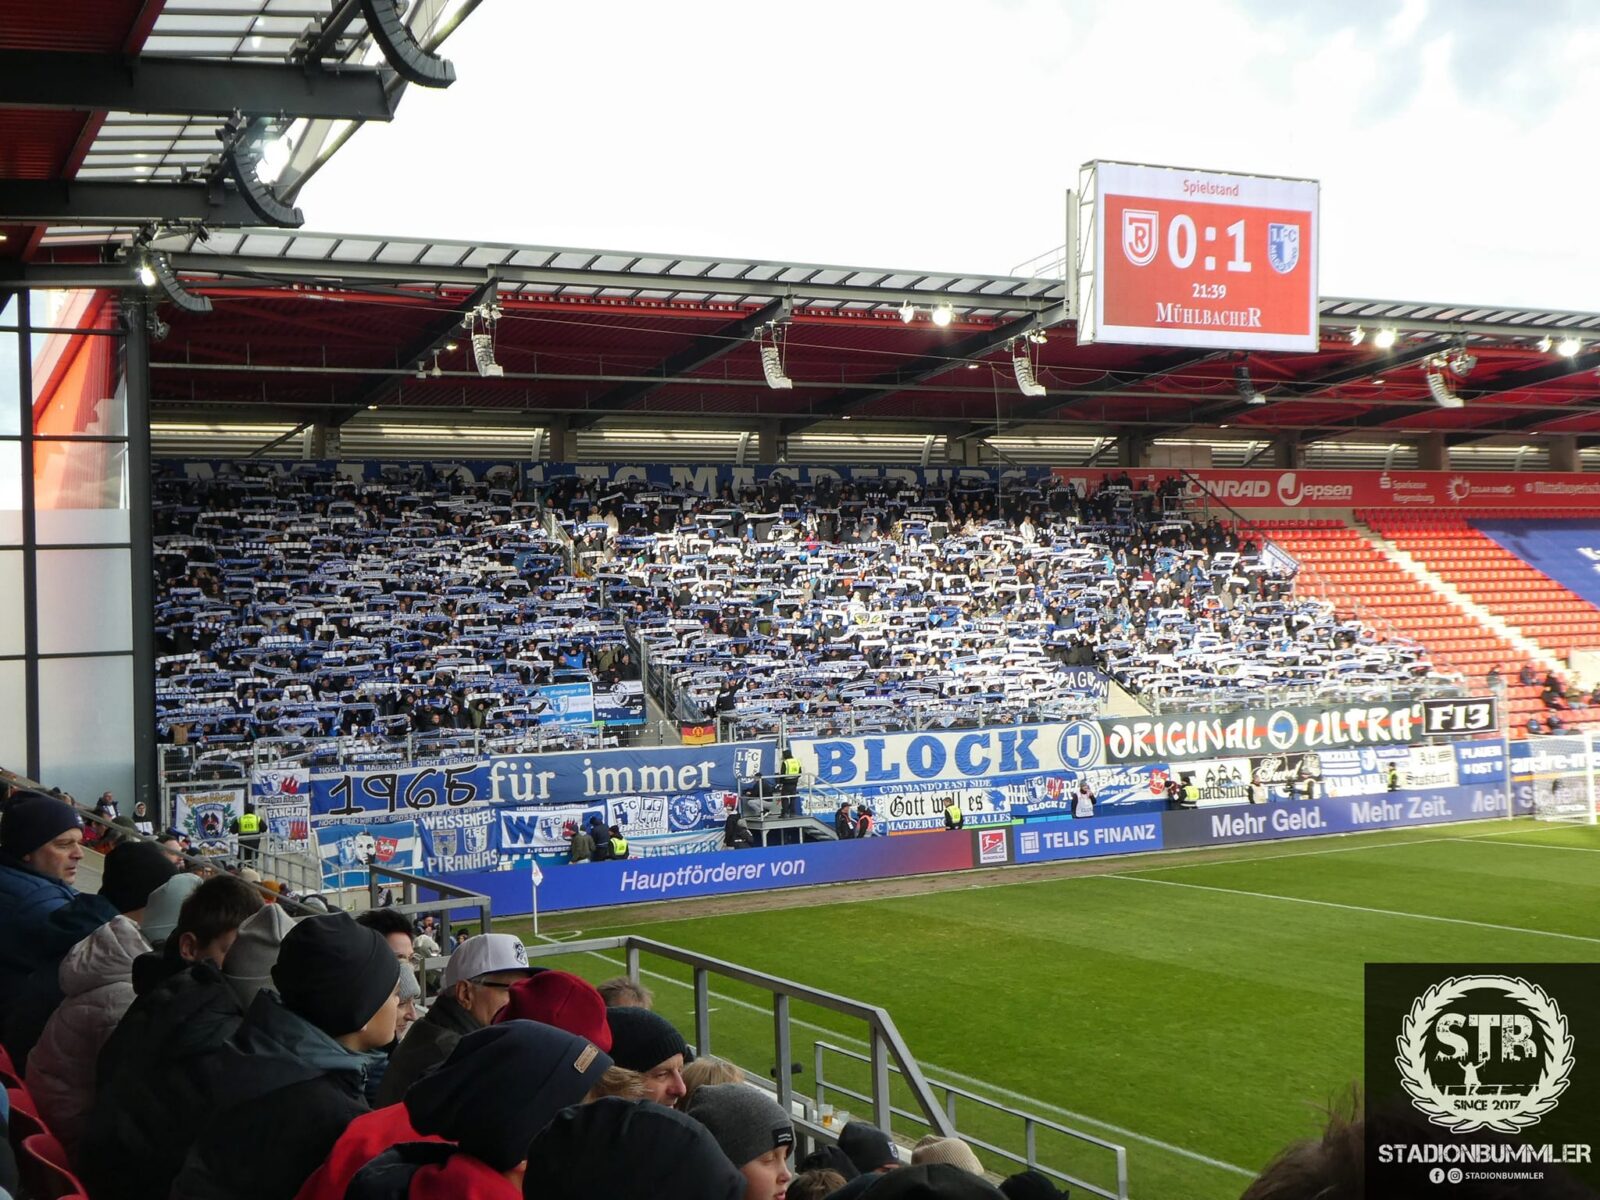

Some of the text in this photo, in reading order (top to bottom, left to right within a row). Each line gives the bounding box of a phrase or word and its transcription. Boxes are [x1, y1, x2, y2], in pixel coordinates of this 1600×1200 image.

[1183, 179, 1240, 197] Spielstand
[1168, 214, 1252, 273] 0:1
[1192, 284, 1227, 299] 21:39
[1156, 302, 1262, 328] MÜHLBACHER
[1109, 715, 1262, 759] ORIGINAL
[319, 766, 342, 774] NOCH
[364, 762, 413, 771] MAGDEBURG
[417, 759, 440, 767] NICHT
[444, 755, 484, 765] VERLOREN
[813, 728, 1040, 786] BLOCK
[328, 764, 479, 817] 1965
[489, 754, 556, 802] für
[583, 758, 716, 797] immer
[880, 779, 992, 794] COMMANDO EAST SIDE
[268, 807, 308, 818] FANCLUB
[890, 792, 984, 817] Gott wll es
[980, 812, 1011, 823] ALLES
[1027, 801, 1059, 812] BLOCK
[1351, 795, 1453, 824] Mehr Zeit.
[319, 818, 341, 827] NOCH
[375, 816, 386, 824] DIE
[422, 807, 497, 831] WEISSENFELS
[1211, 806, 1327, 838] Mehr Geld.
[1043, 823, 1156, 849] TELIS FINANZ
[428, 847, 500, 873] PIRANHAS
[620, 859, 806, 892] Hauptförderer von
